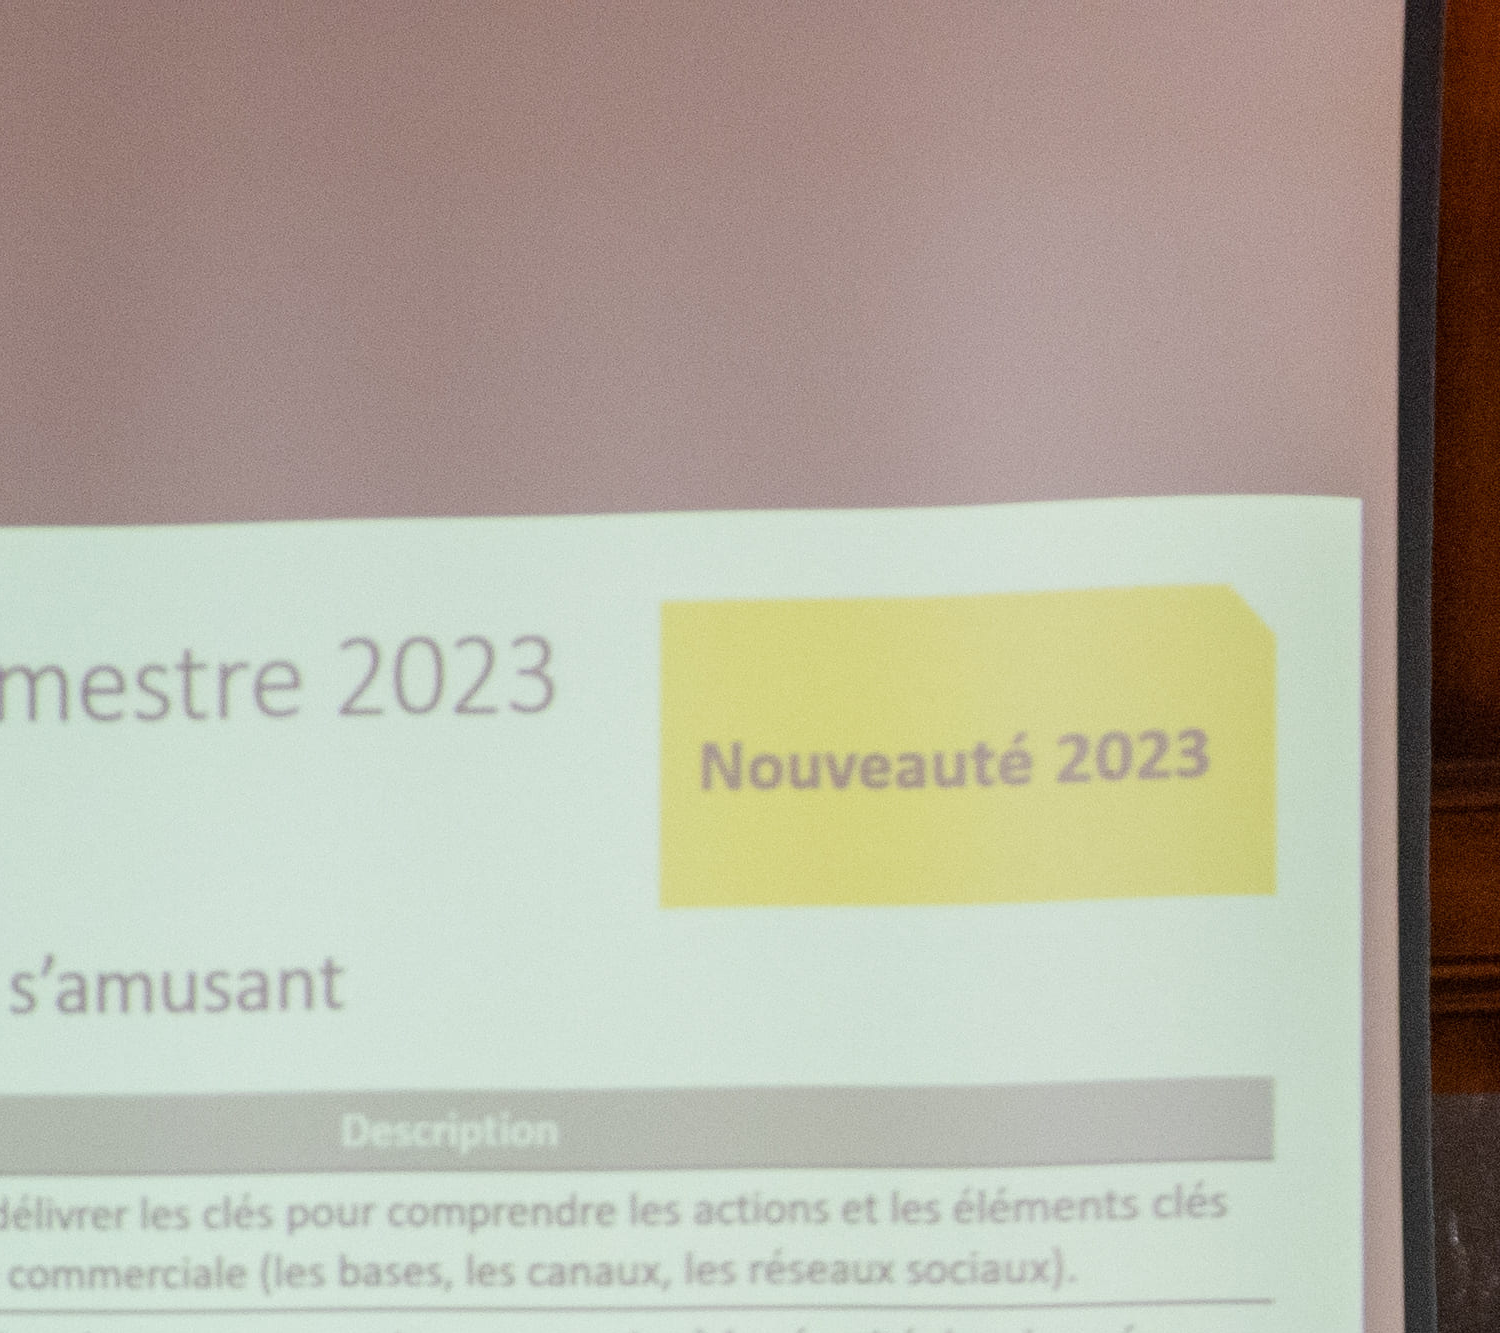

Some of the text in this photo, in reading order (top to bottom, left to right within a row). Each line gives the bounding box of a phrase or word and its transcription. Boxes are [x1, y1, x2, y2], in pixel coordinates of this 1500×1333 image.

[341, 633, 558, 719] 2023
[699, 726, 1212, 793] Nouveauté 2023
[339, 1111, 562, 1156] Description
[138, 1196, 193, 1233] les
[200, 1194, 276, 1233] clés
[284, 1201, 378, 1237] pour
[385, 1194, 619, 1235] comprendre
[627, 1192, 684, 1229] les
[691, 1193, 832, 1228] actions
[838, 1193, 880, 1227] et
[888, 1190, 944, 1227] les
[950, 1187, 1142, 1227] éléments
[1150, 1181, 1230, 1221] clés
[5, 1255, 250, 1292] commerciale
[257, 1251, 328, 1297] (les
[336, 1252, 455, 1293] bases,
[464, 1252, 518, 1289] les
[524, 1260, 673, 1292] canaux,
[683, 1250, 739, 1288] les
[747, 1248, 896, 1287] réseaux
[905, 1246, 1077, 1291] sociaux).
